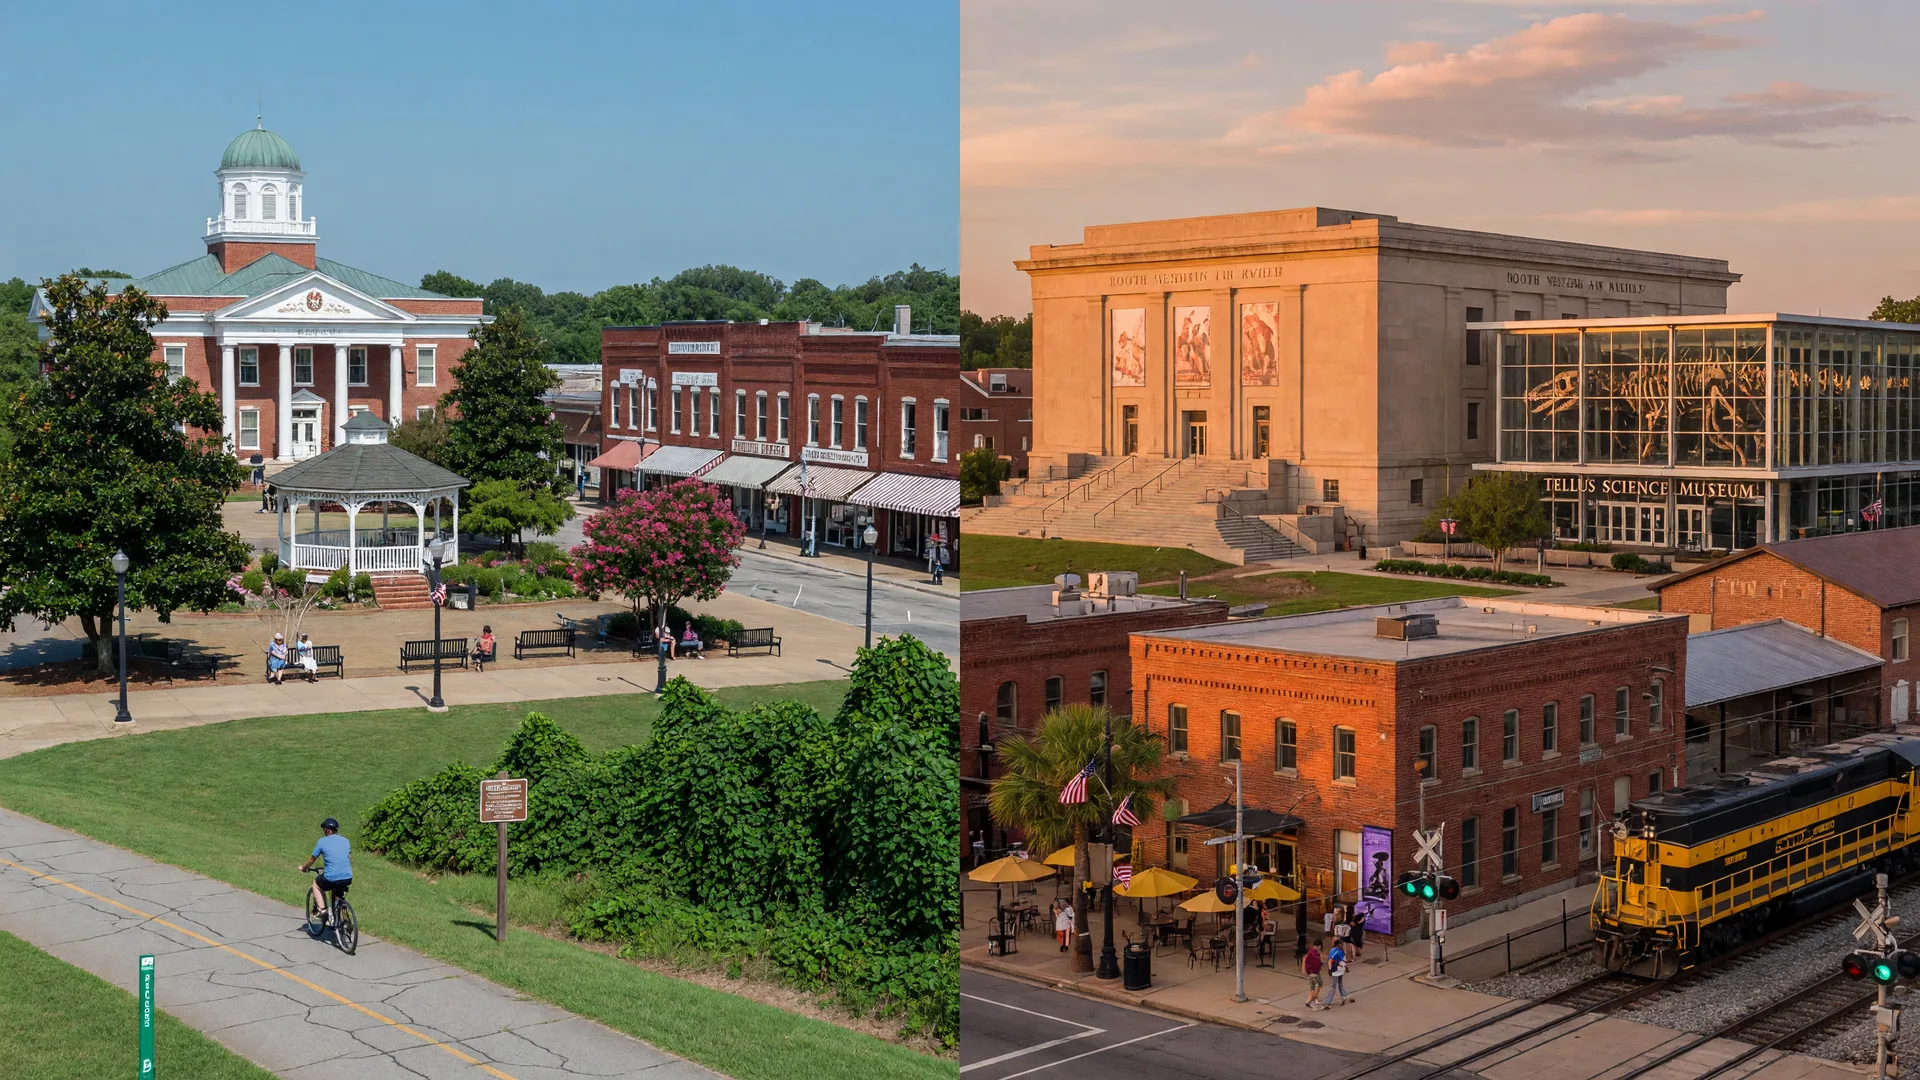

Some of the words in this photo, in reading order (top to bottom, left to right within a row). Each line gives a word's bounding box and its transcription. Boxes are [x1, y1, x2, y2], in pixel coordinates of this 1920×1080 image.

[1543, 477, 1596, 493] TELLUS
[1602, 479, 1669, 496] SCIENCE
[1679, 481, 1754, 499] MUSEUM
